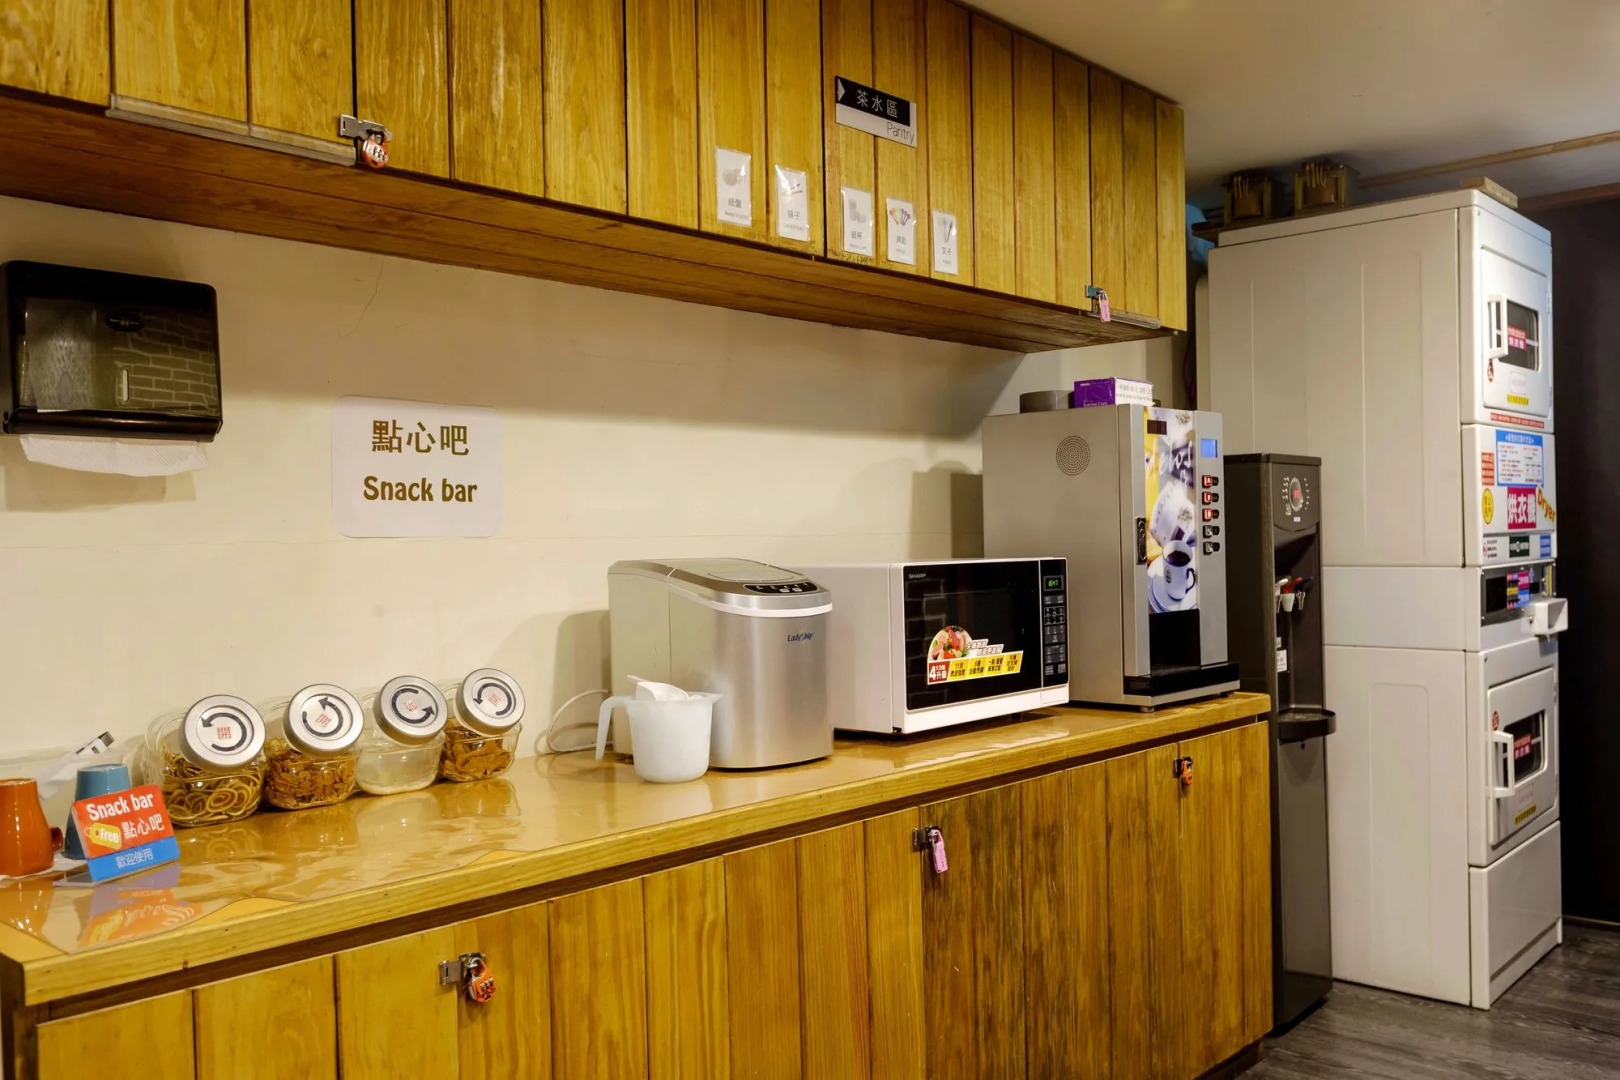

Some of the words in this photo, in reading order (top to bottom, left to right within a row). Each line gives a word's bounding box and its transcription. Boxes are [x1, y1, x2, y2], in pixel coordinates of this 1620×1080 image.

[856, 90, 898, 118] 茶水區
[886, 121, 915, 145] Pantry
[371, 419, 470, 456] 點心吧
[363, 475, 434, 502] Snack
[441, 478, 478, 503] bar
[1508, 493, 1536, 524] 烘衣機
[1537, 488, 1556, 523] Dryer
[216, 726, 232, 740] 開
[86, 797, 130, 821] Snack
[129, 793, 154, 811] bar
[121, 813, 164, 840] 點心吧
[115, 848, 154, 869] 歡迎使用
